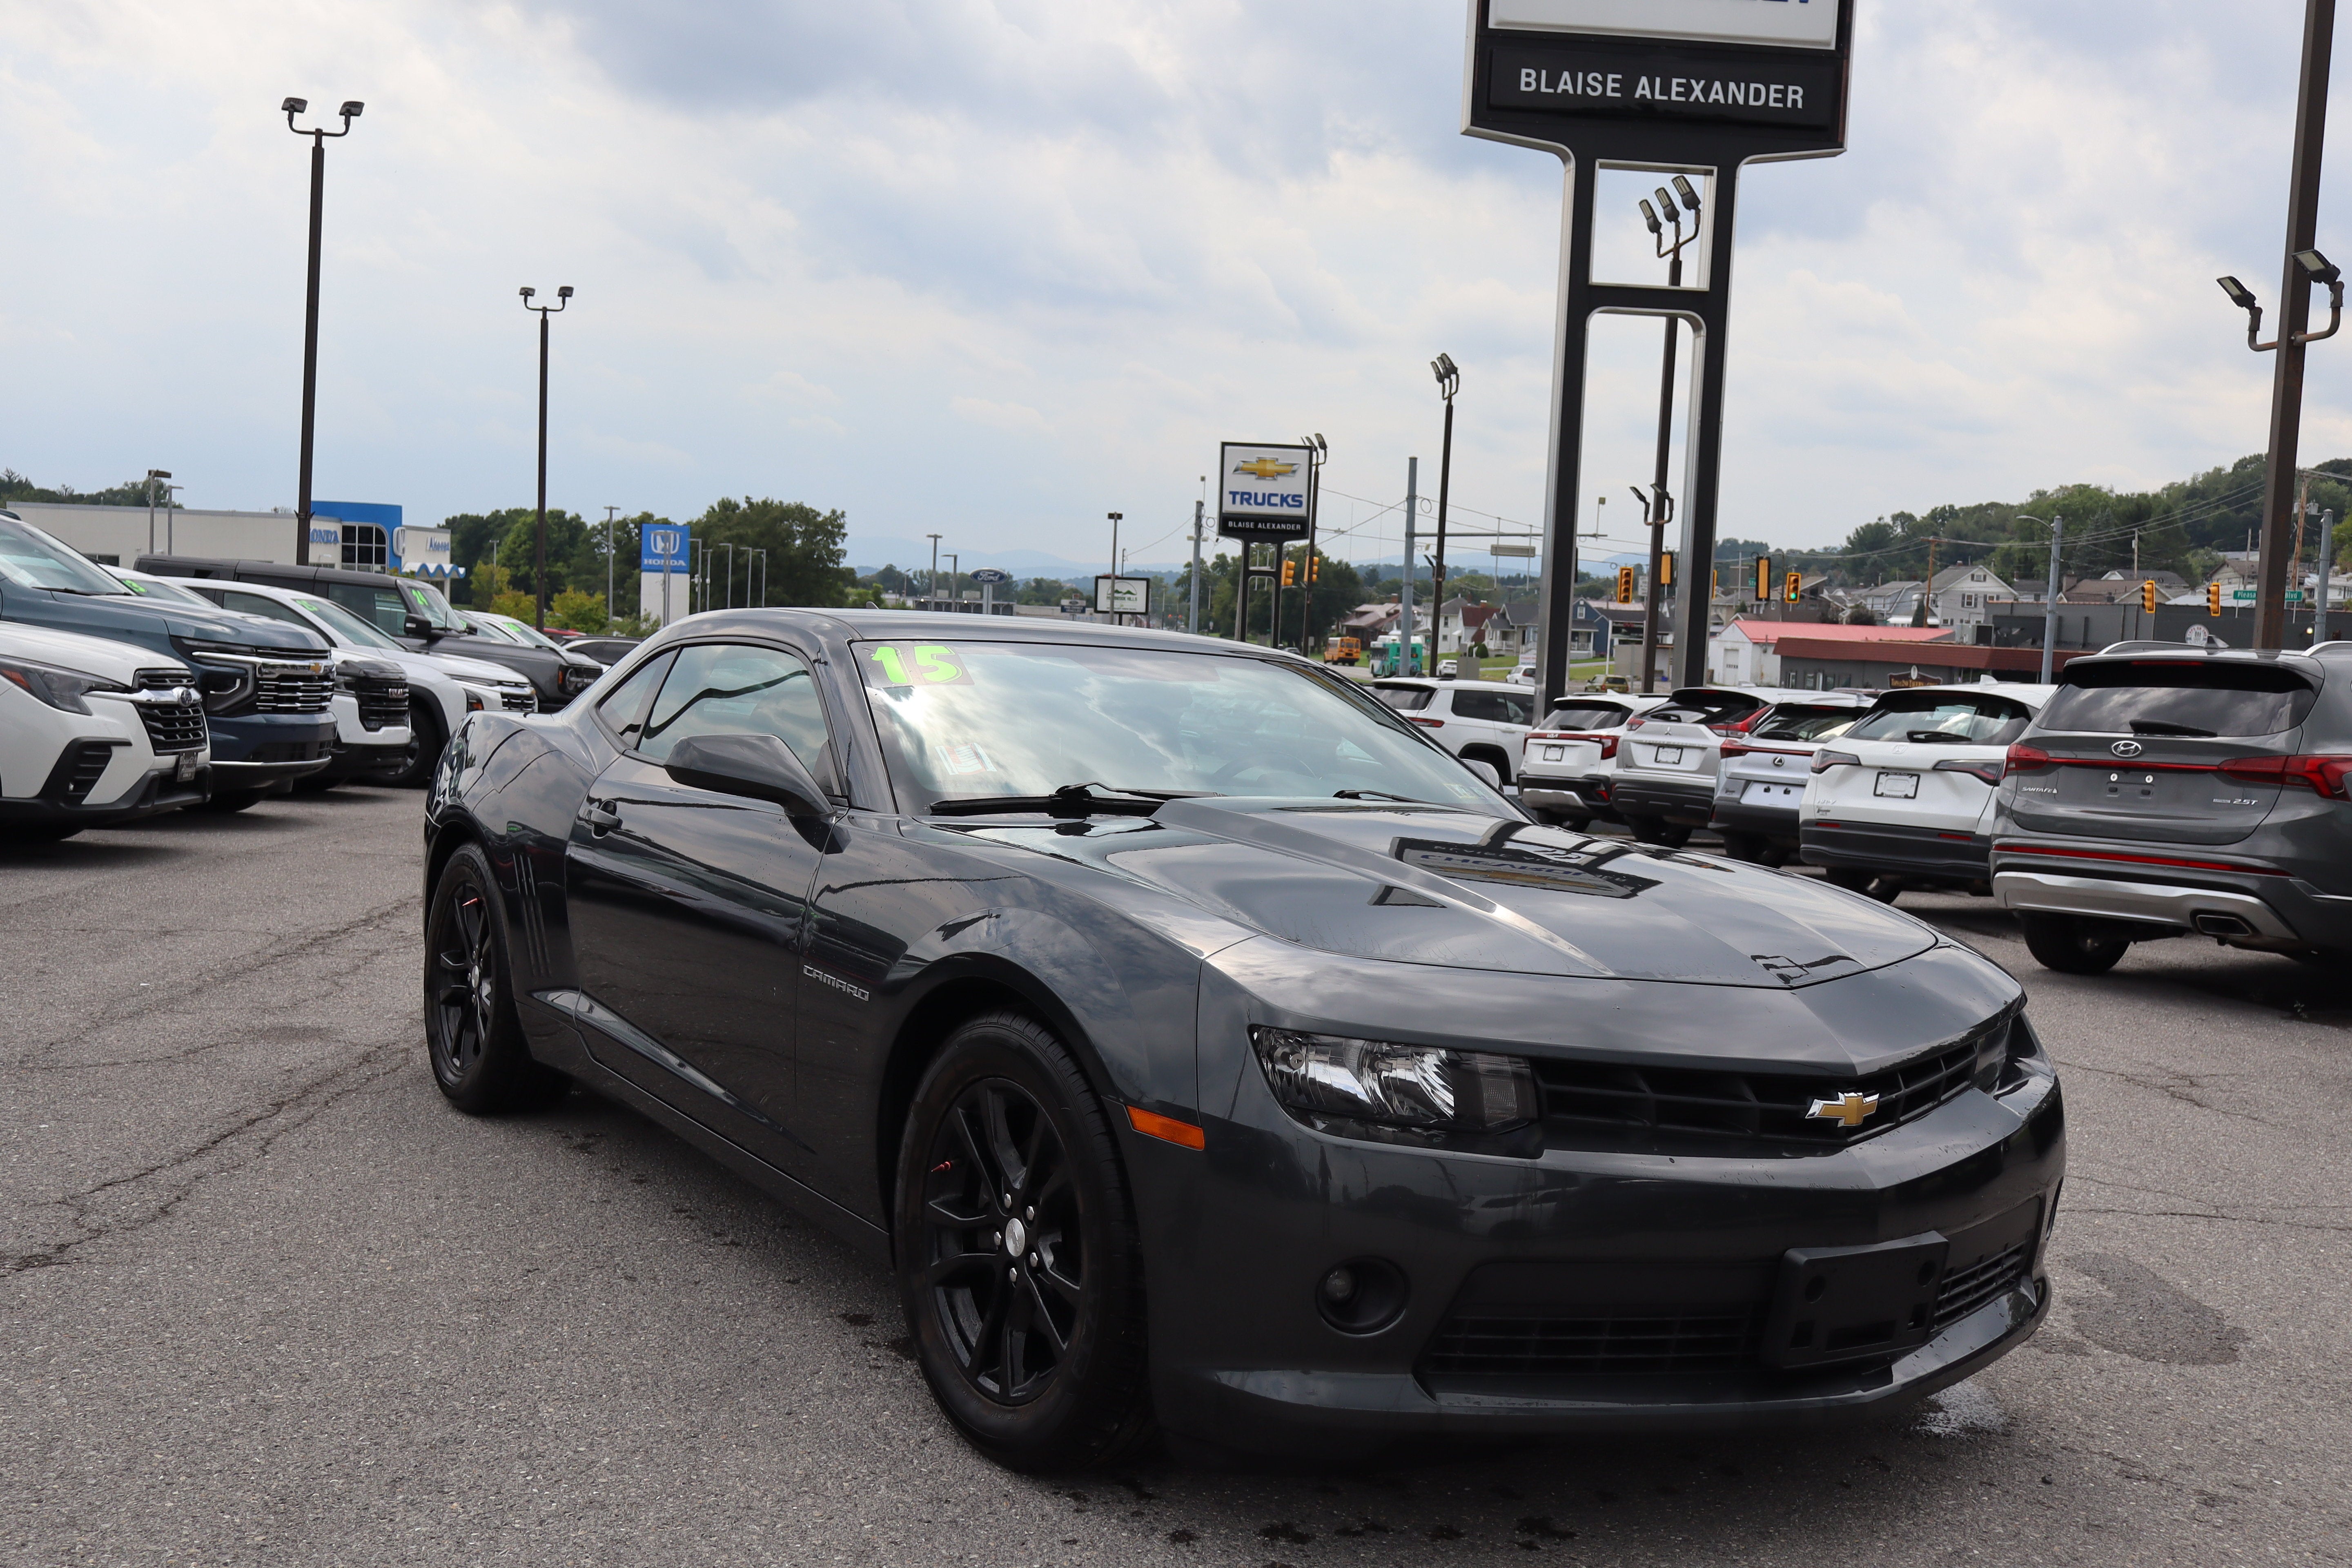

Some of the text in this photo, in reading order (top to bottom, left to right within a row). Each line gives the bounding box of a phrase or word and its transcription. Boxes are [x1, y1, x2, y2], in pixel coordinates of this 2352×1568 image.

[1520, 68, 1803, 109] BLAISE ALEXANDER
[1229, 491, 1303, 508] TRUCKS
[310, 528, 340, 544] ONDA
[978, 571, 1000, 581] Ford
[871, 645, 963, 684] 15
[803, 964, 870, 1002] CAMARO
